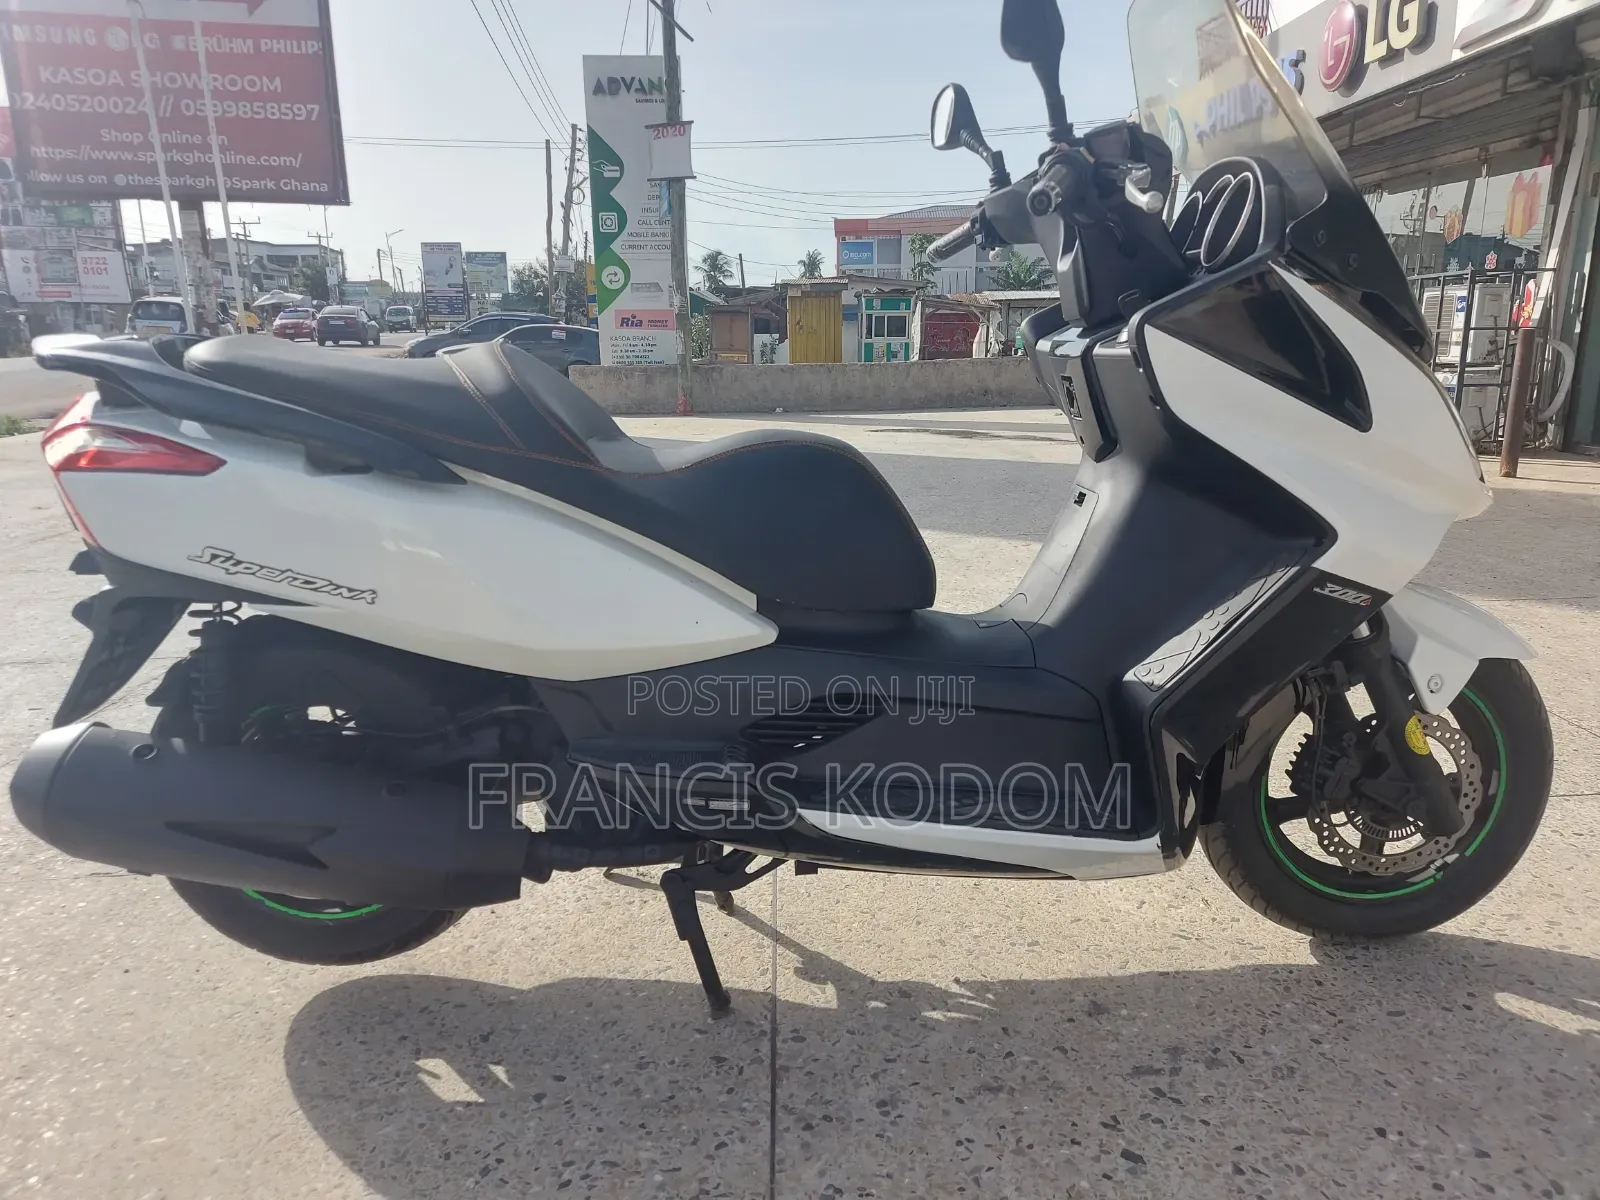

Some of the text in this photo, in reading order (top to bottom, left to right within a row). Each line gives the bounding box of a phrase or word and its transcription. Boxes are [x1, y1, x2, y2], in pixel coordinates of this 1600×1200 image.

[1, 23, 97, 46] MSUNG
[39, 65, 282, 93] KASOA SHOWROOM
[592, 76, 664, 96] ADVAN
[180, 98, 321, 121] 0599858597
[101, 128, 144, 145] Shop
[652, 124, 687, 140] 2020
[30, 145, 303, 169] https://www.sprkghonline.com/
[66, 174, 84, 184] us
[88, 174, 108, 184] on
[279, 178, 329, 192] Ghana
[650, 243, 671, 251] ACCOU
[80, 256, 109, 266] 9722
[82, 266, 109, 276] 0101
[620, 314, 643, 328] Ria
